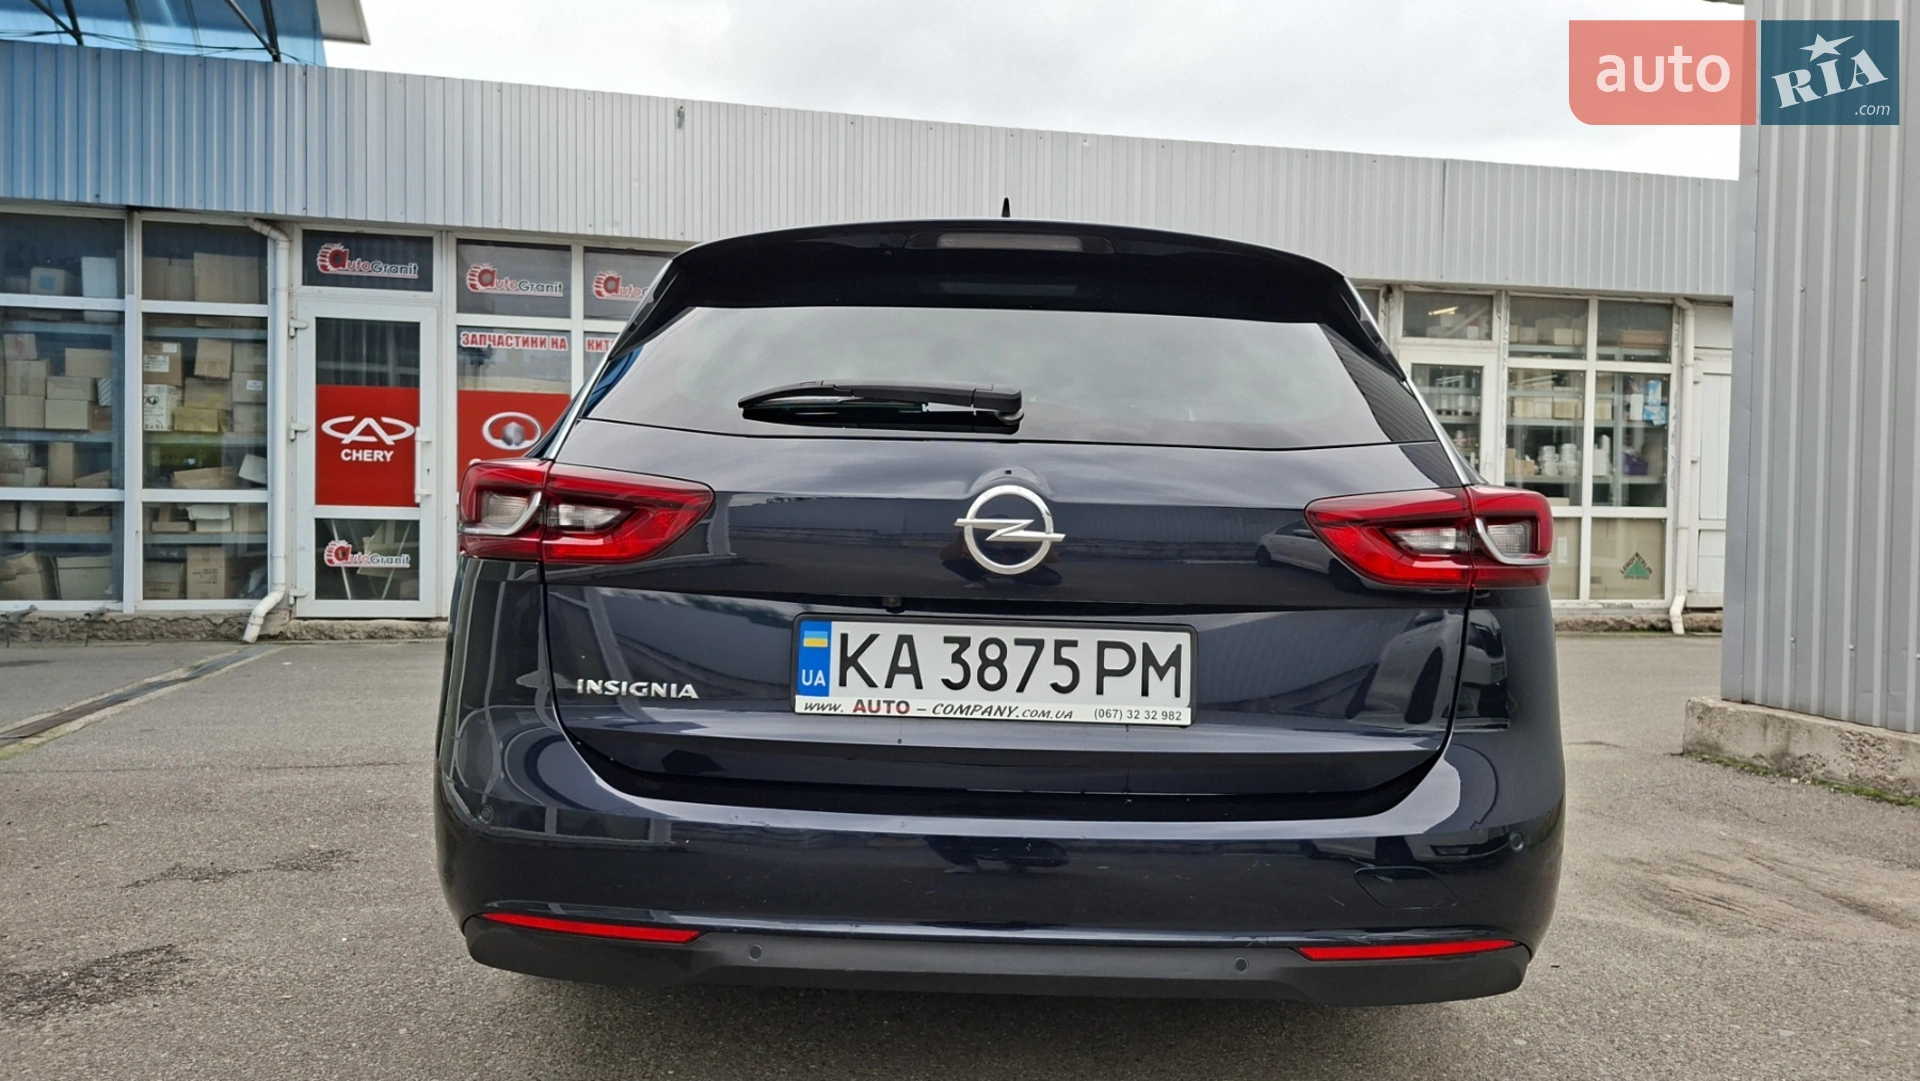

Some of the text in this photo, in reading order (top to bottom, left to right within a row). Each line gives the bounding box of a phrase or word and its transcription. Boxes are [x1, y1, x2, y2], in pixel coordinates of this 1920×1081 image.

[461, 333, 614, 351] ЗАПЧАСТИНИ НА КИТ
[341, 449, 394, 463] CHERY
[838, 633, 1182, 698] KA 3875 PM
[801, 669, 826, 687] UA
[576, 679, 699, 699] INSIGNIA
[853, 700, 910, 714] AUTO
[1094, 709, 1123, 721] (067)
[1126, 711, 1140, 720] 32
[1144, 711, 1158, 721] 32
[1161, 711, 1182, 721] 982
